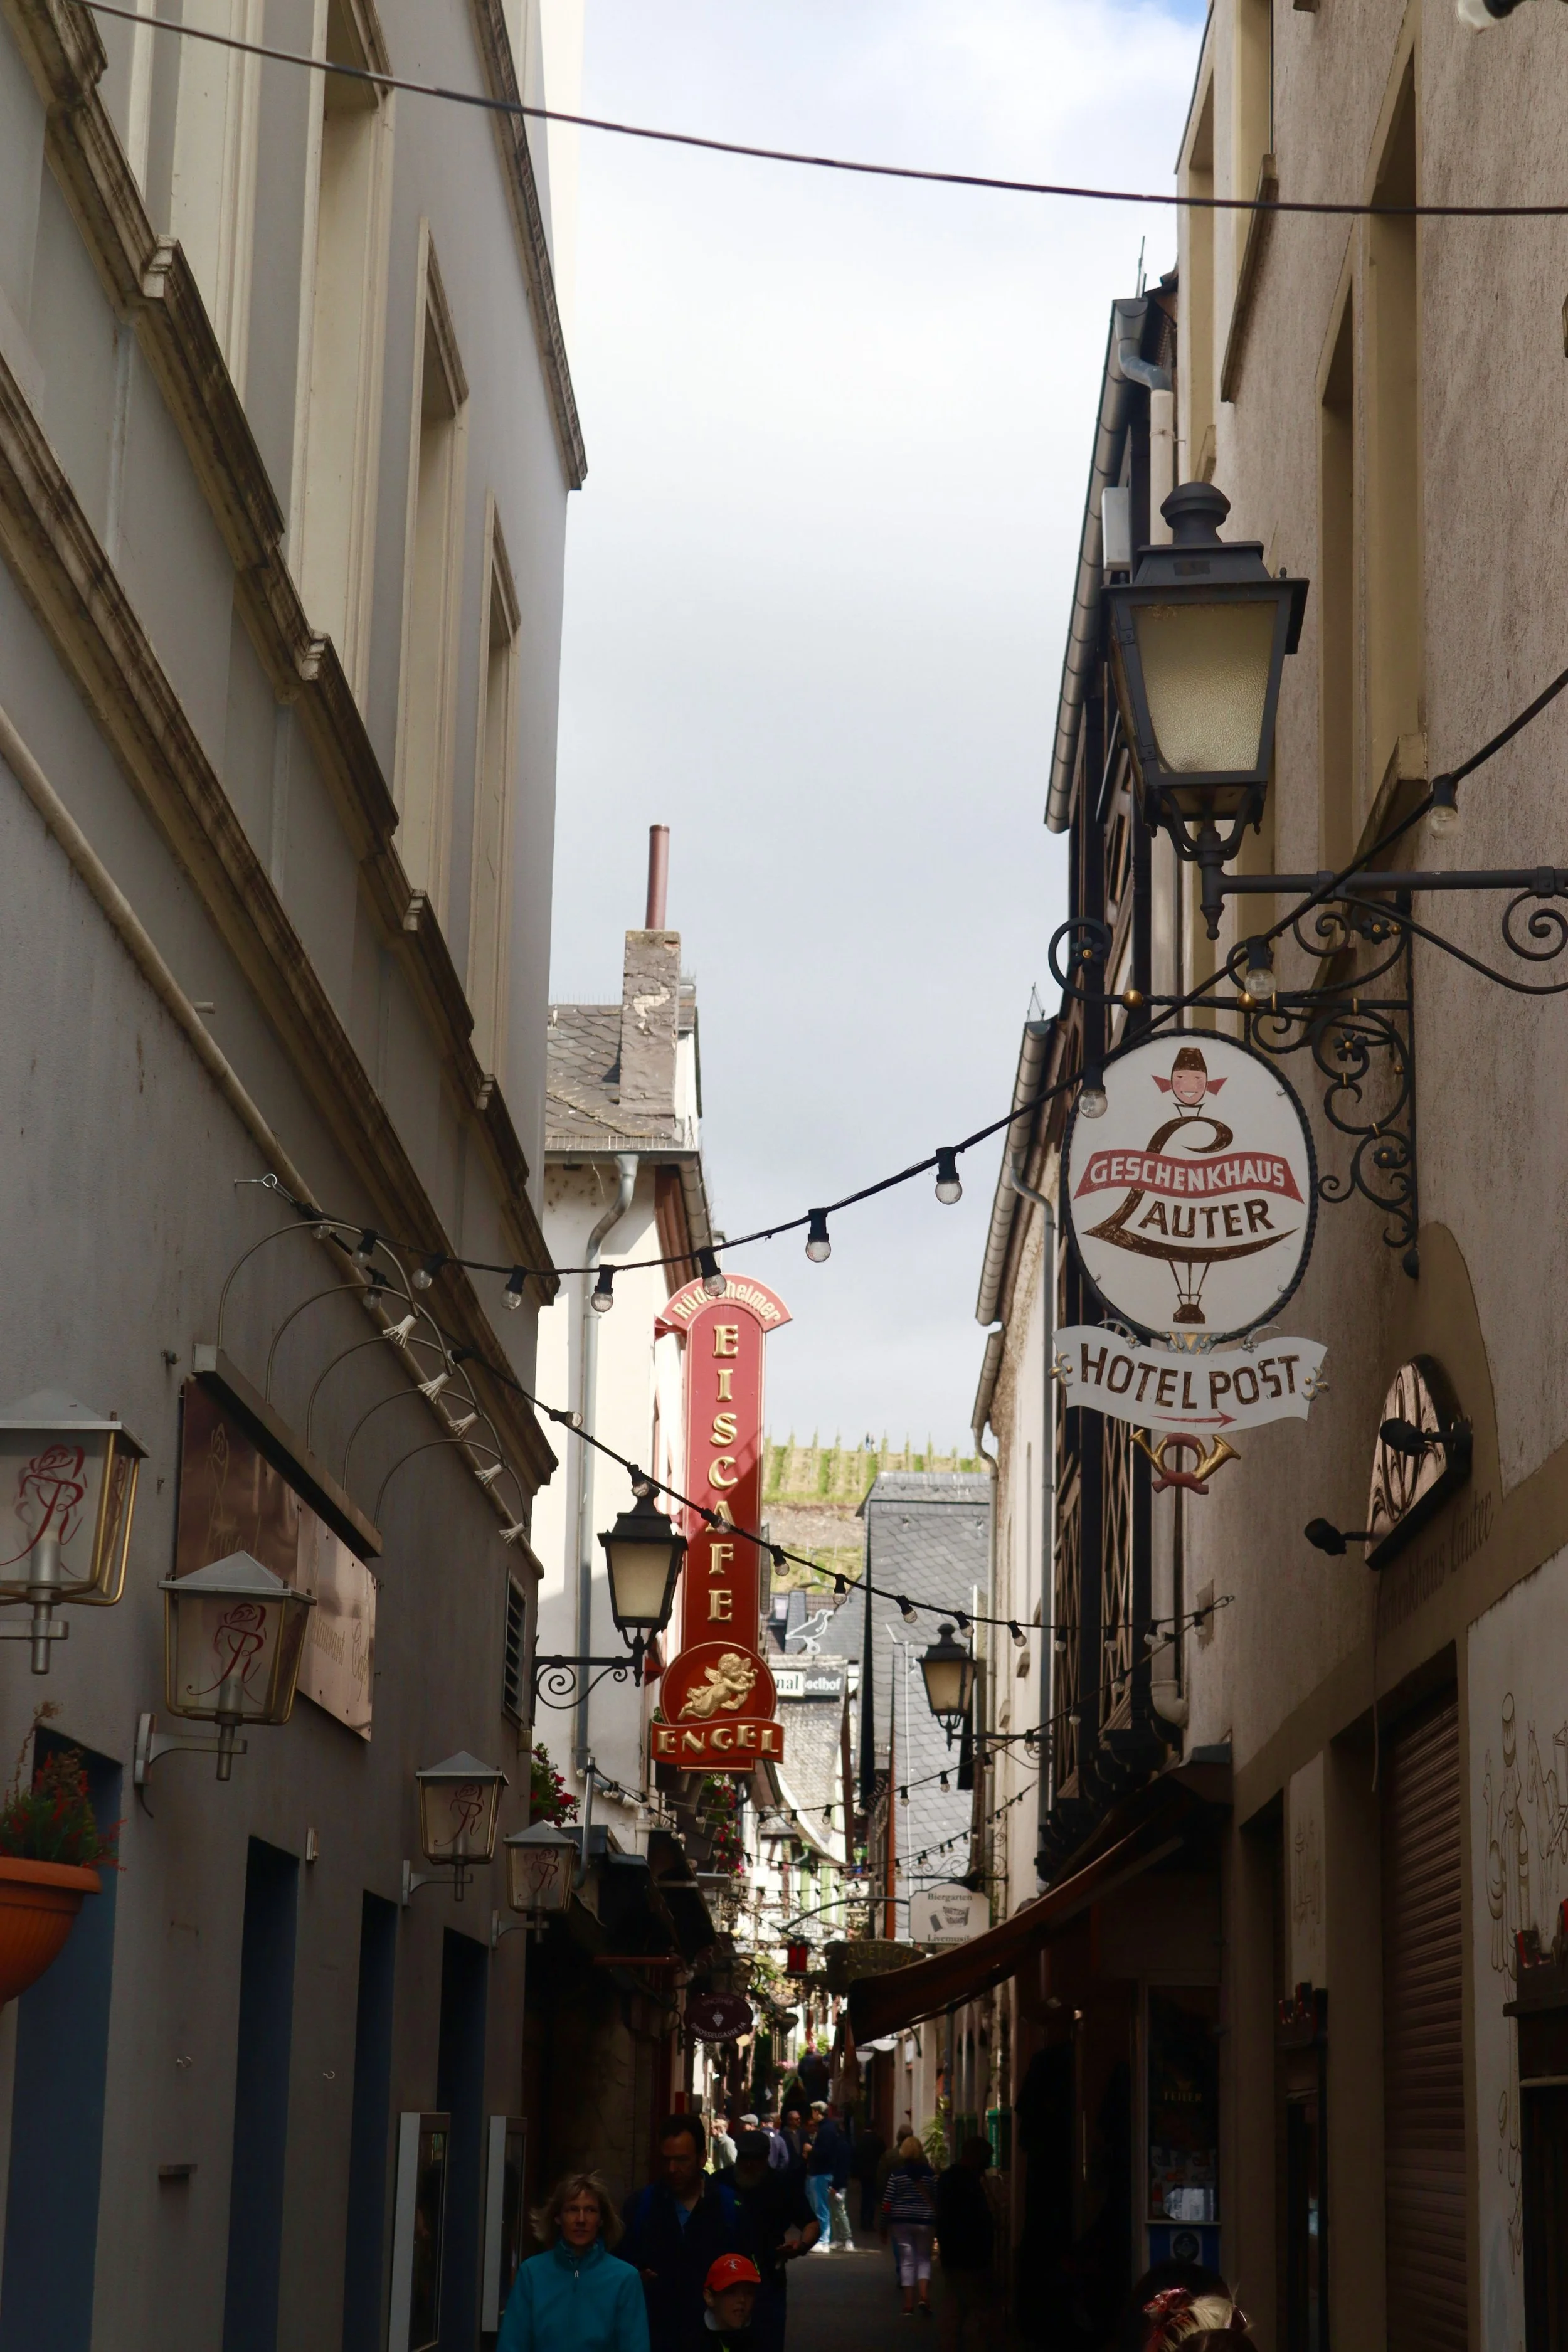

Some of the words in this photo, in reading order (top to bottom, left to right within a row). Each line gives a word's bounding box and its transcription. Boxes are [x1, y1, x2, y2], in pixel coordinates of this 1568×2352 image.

[1089, 1156, 1285, 1192] GESCHENKHAUS
[672, 1279, 781, 1322] Rüdheimer
[1080, 1343, 1198, 1409] HOTEL
[1208, 1355, 1300, 1409] POST
[657, 1724, 780, 1754] ENGEL
[927, 1892, 973, 1902] Biergarten
[691, 2022, 739, 2038] DROSSELGASSE
